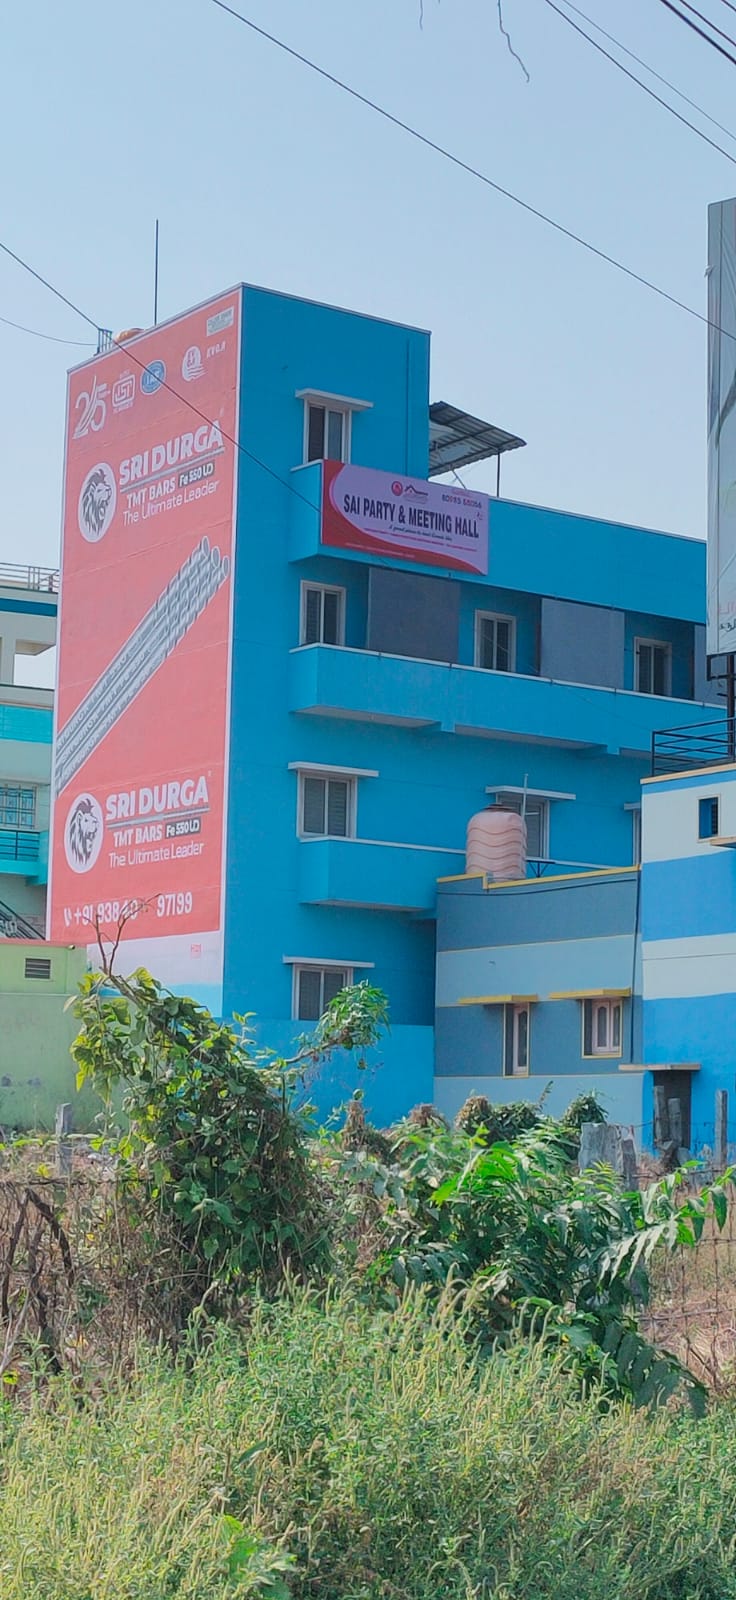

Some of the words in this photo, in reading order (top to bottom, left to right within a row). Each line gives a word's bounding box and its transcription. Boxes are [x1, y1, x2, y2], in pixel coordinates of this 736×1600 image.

[119, 450, 149, 486] SRI
[151, 420, 224, 472] DURGA
[122, 510, 140, 527] The
[141, 494, 183, 519] Ultimate
[184, 480, 220, 504] Leader
[126, 487, 148, 509] TMT
[149, 476, 176, 500] BARS
[343, 494, 361, 515] SAI
[363, 498, 396, 522] PARTY
[398, 505, 406, 525] &
[408, 506, 453, 534] MEETING
[454, 516, 480, 539] HALL
[106, 790, 136, 821] SRI
[138, 775, 209, 815] DURGA
[108, 852, 126, 869] The
[127, 847, 170, 866] Ultimate
[171, 841, 205, 859] Leader
[113, 828, 133, 848] TMT
[135, 824, 162, 844] BARS
[156, 891, 193, 917] 97199
